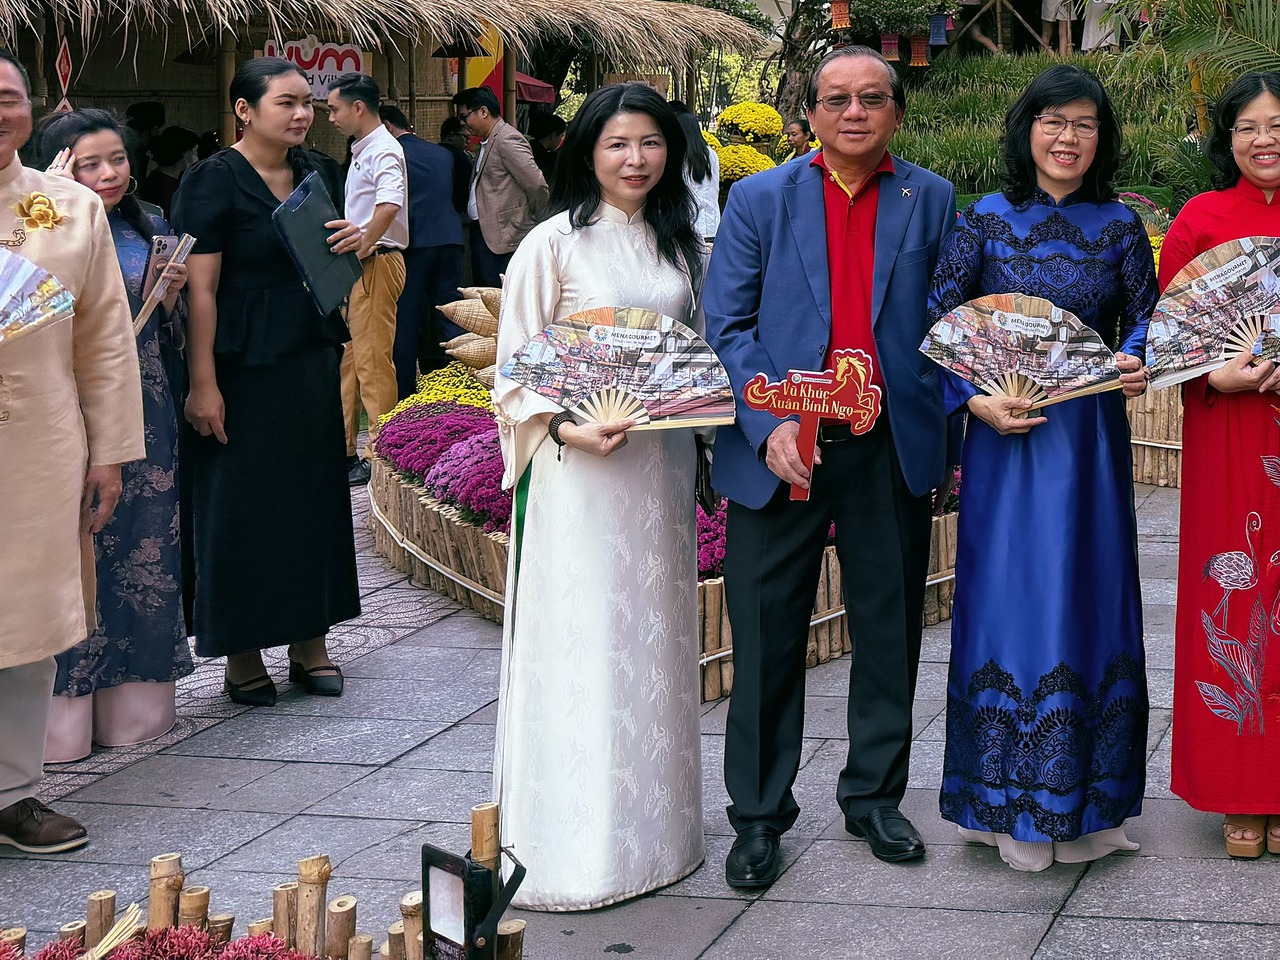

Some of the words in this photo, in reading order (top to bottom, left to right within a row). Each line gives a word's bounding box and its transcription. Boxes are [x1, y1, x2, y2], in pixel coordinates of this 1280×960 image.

[783, 382, 798, 396] Vũ
[799, 383, 830, 400] Khúc
[769, 394, 800, 410] Xuân
[802, 398, 829, 413] Bính
[831, 401, 854, 419] Ngọ
